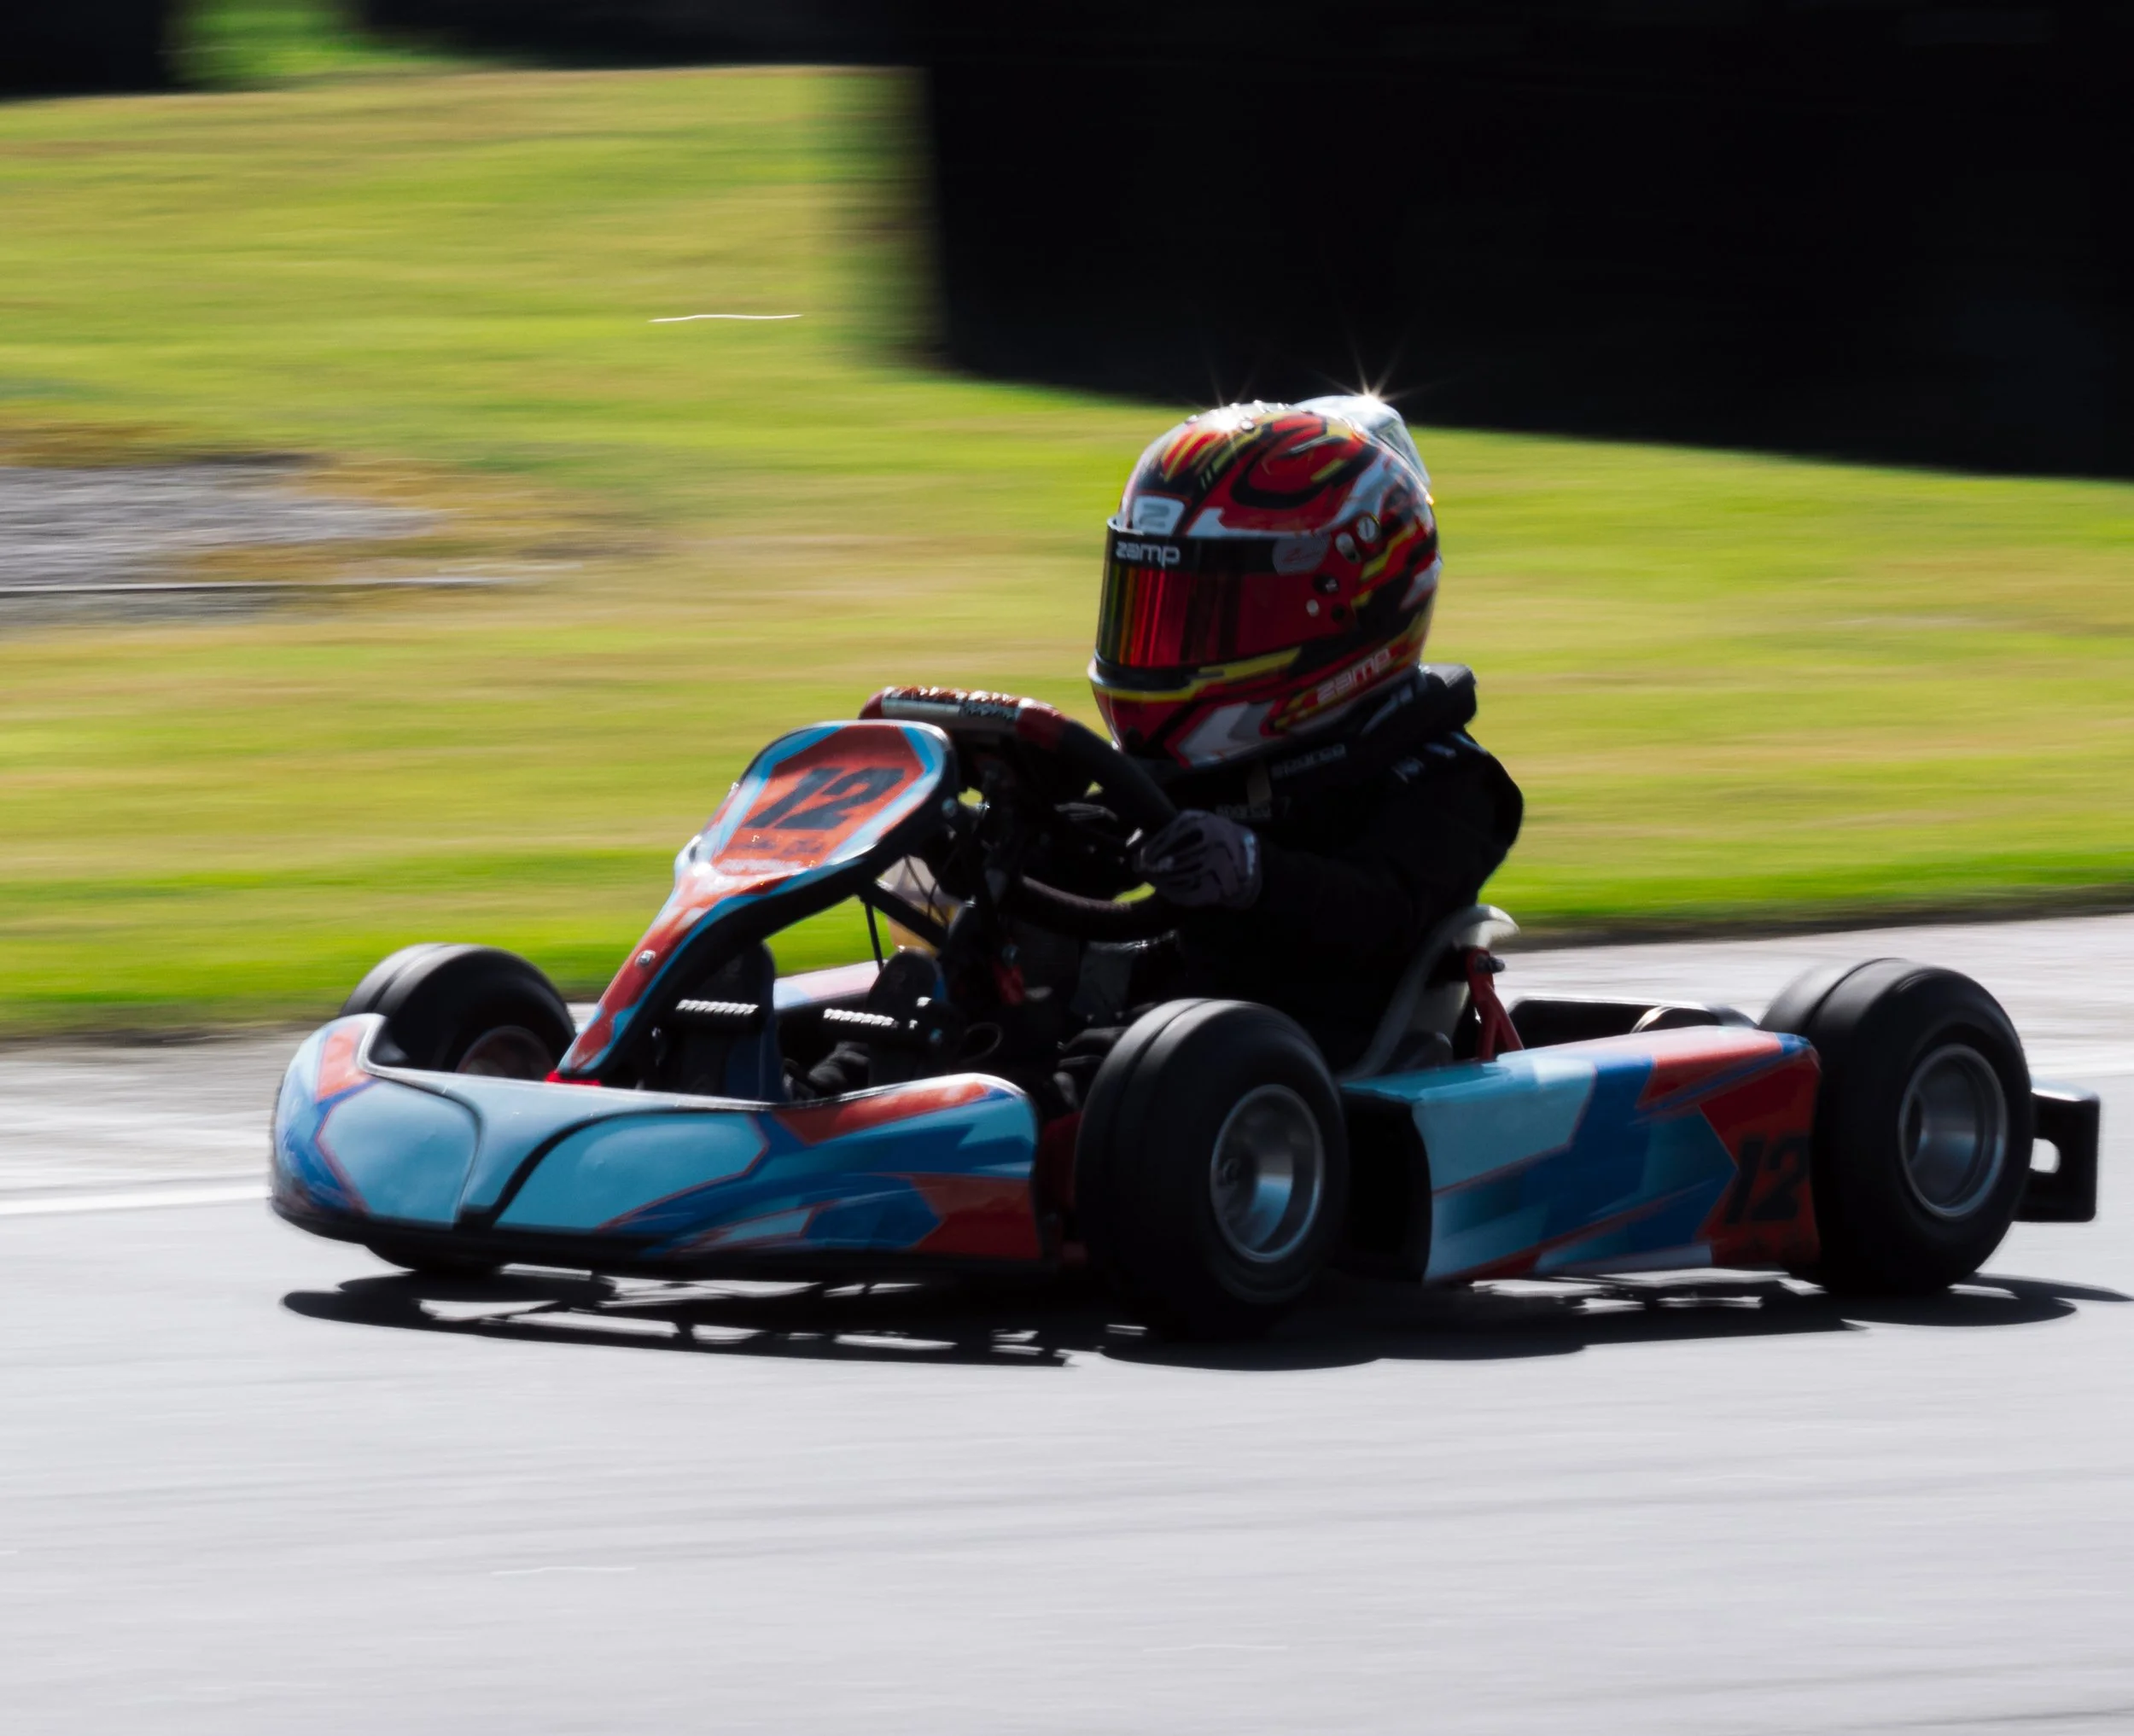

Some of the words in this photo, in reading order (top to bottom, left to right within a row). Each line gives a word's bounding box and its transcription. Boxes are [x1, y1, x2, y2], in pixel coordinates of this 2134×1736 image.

[1115, 540, 1181, 569] zamp
[1316, 648, 1391, 703] zamp
[741, 767, 905, 830] 12
[1724, 1136, 1813, 1225] 12
